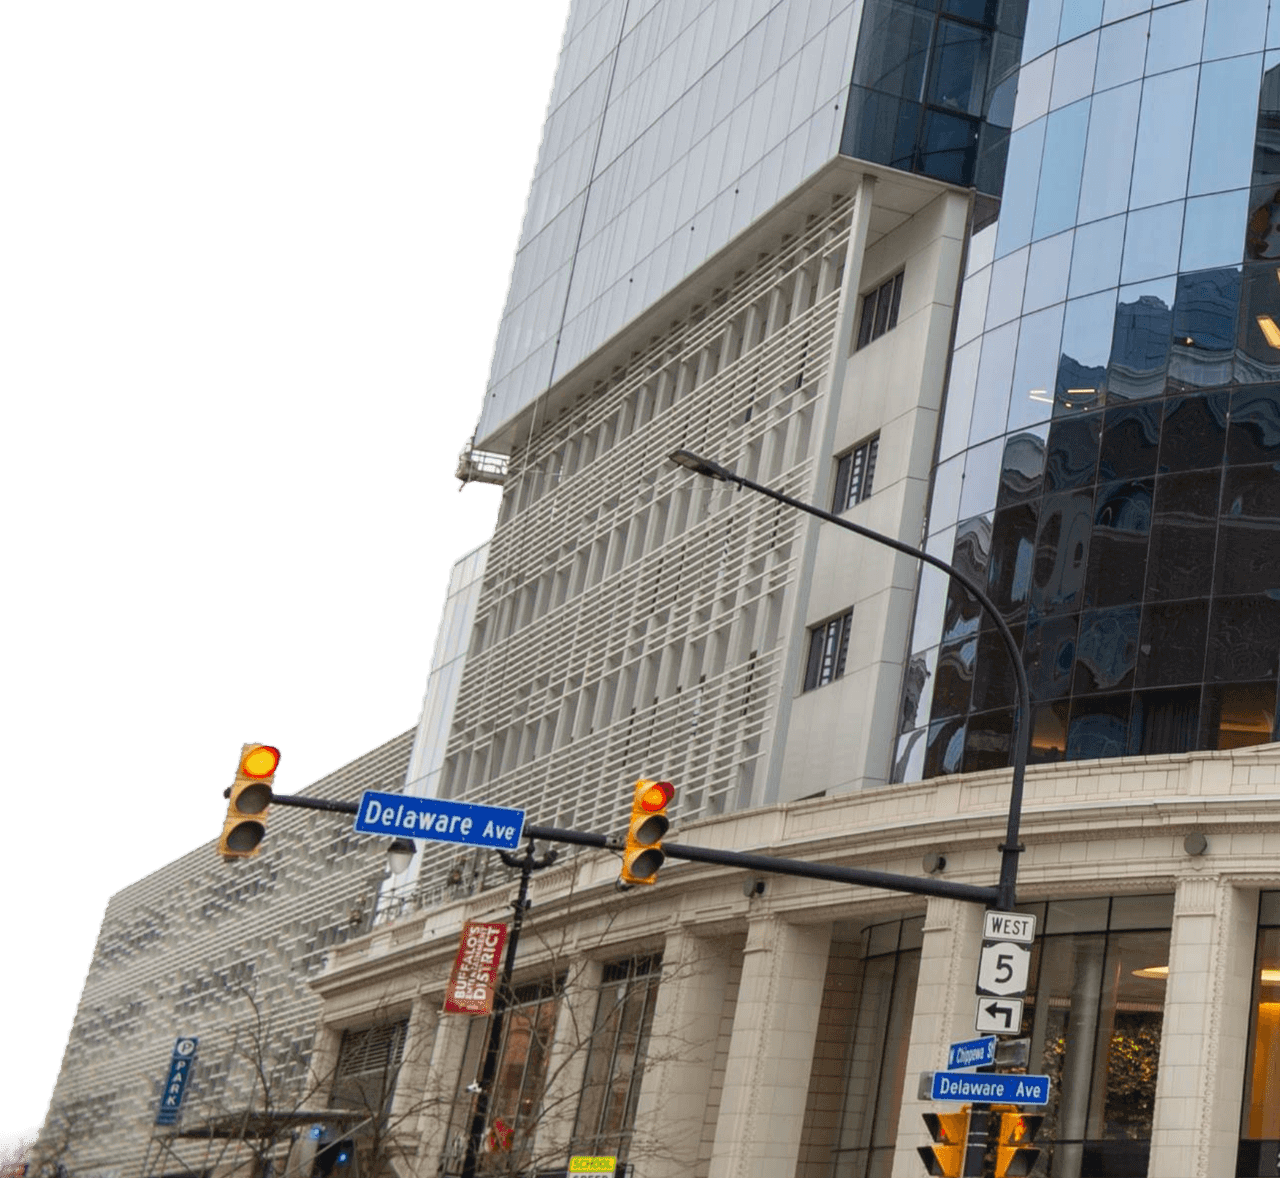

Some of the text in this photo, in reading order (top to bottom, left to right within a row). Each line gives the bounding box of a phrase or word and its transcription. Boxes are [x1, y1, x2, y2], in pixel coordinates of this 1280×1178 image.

[364, 800, 516, 841] Delaware Ave
[991, 916, 1029, 936] WEST
[454, 926, 480, 999] BUFFALO'S
[474, 926, 501, 1000] DISTRICT
[994, 954, 1014, 984] 5
[167, 1060, 186, 1106] PARK
[940, 1077, 1041, 1098] Delaware Ave
